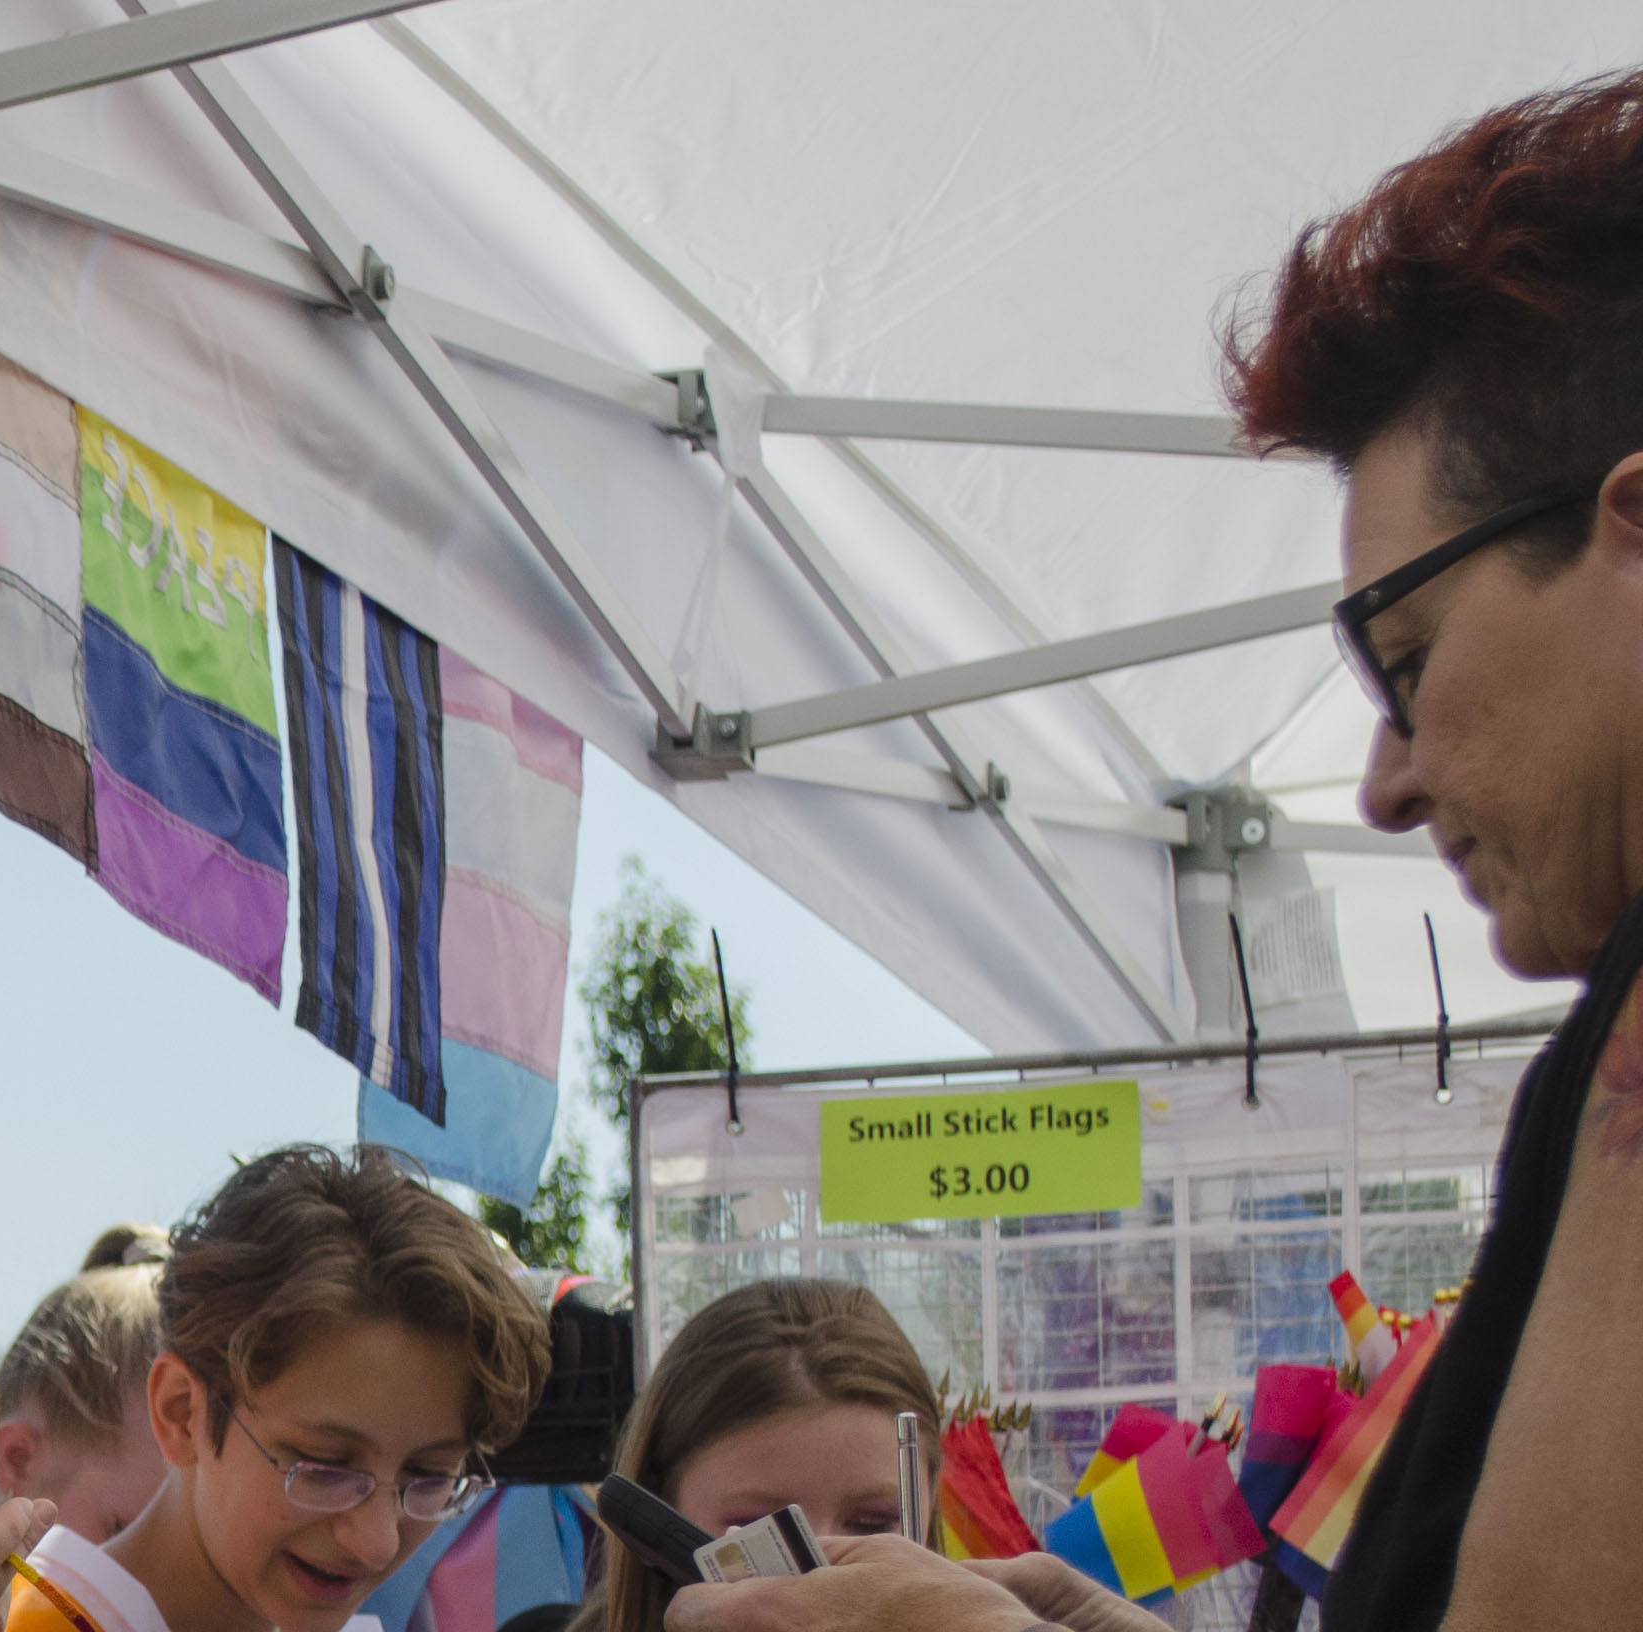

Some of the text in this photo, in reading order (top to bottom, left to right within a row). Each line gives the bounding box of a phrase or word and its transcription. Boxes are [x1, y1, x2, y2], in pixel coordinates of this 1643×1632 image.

[849, 1104, 1110, 1143] Small Stick Flags
[928, 1163, 1030, 1201] $3.00
